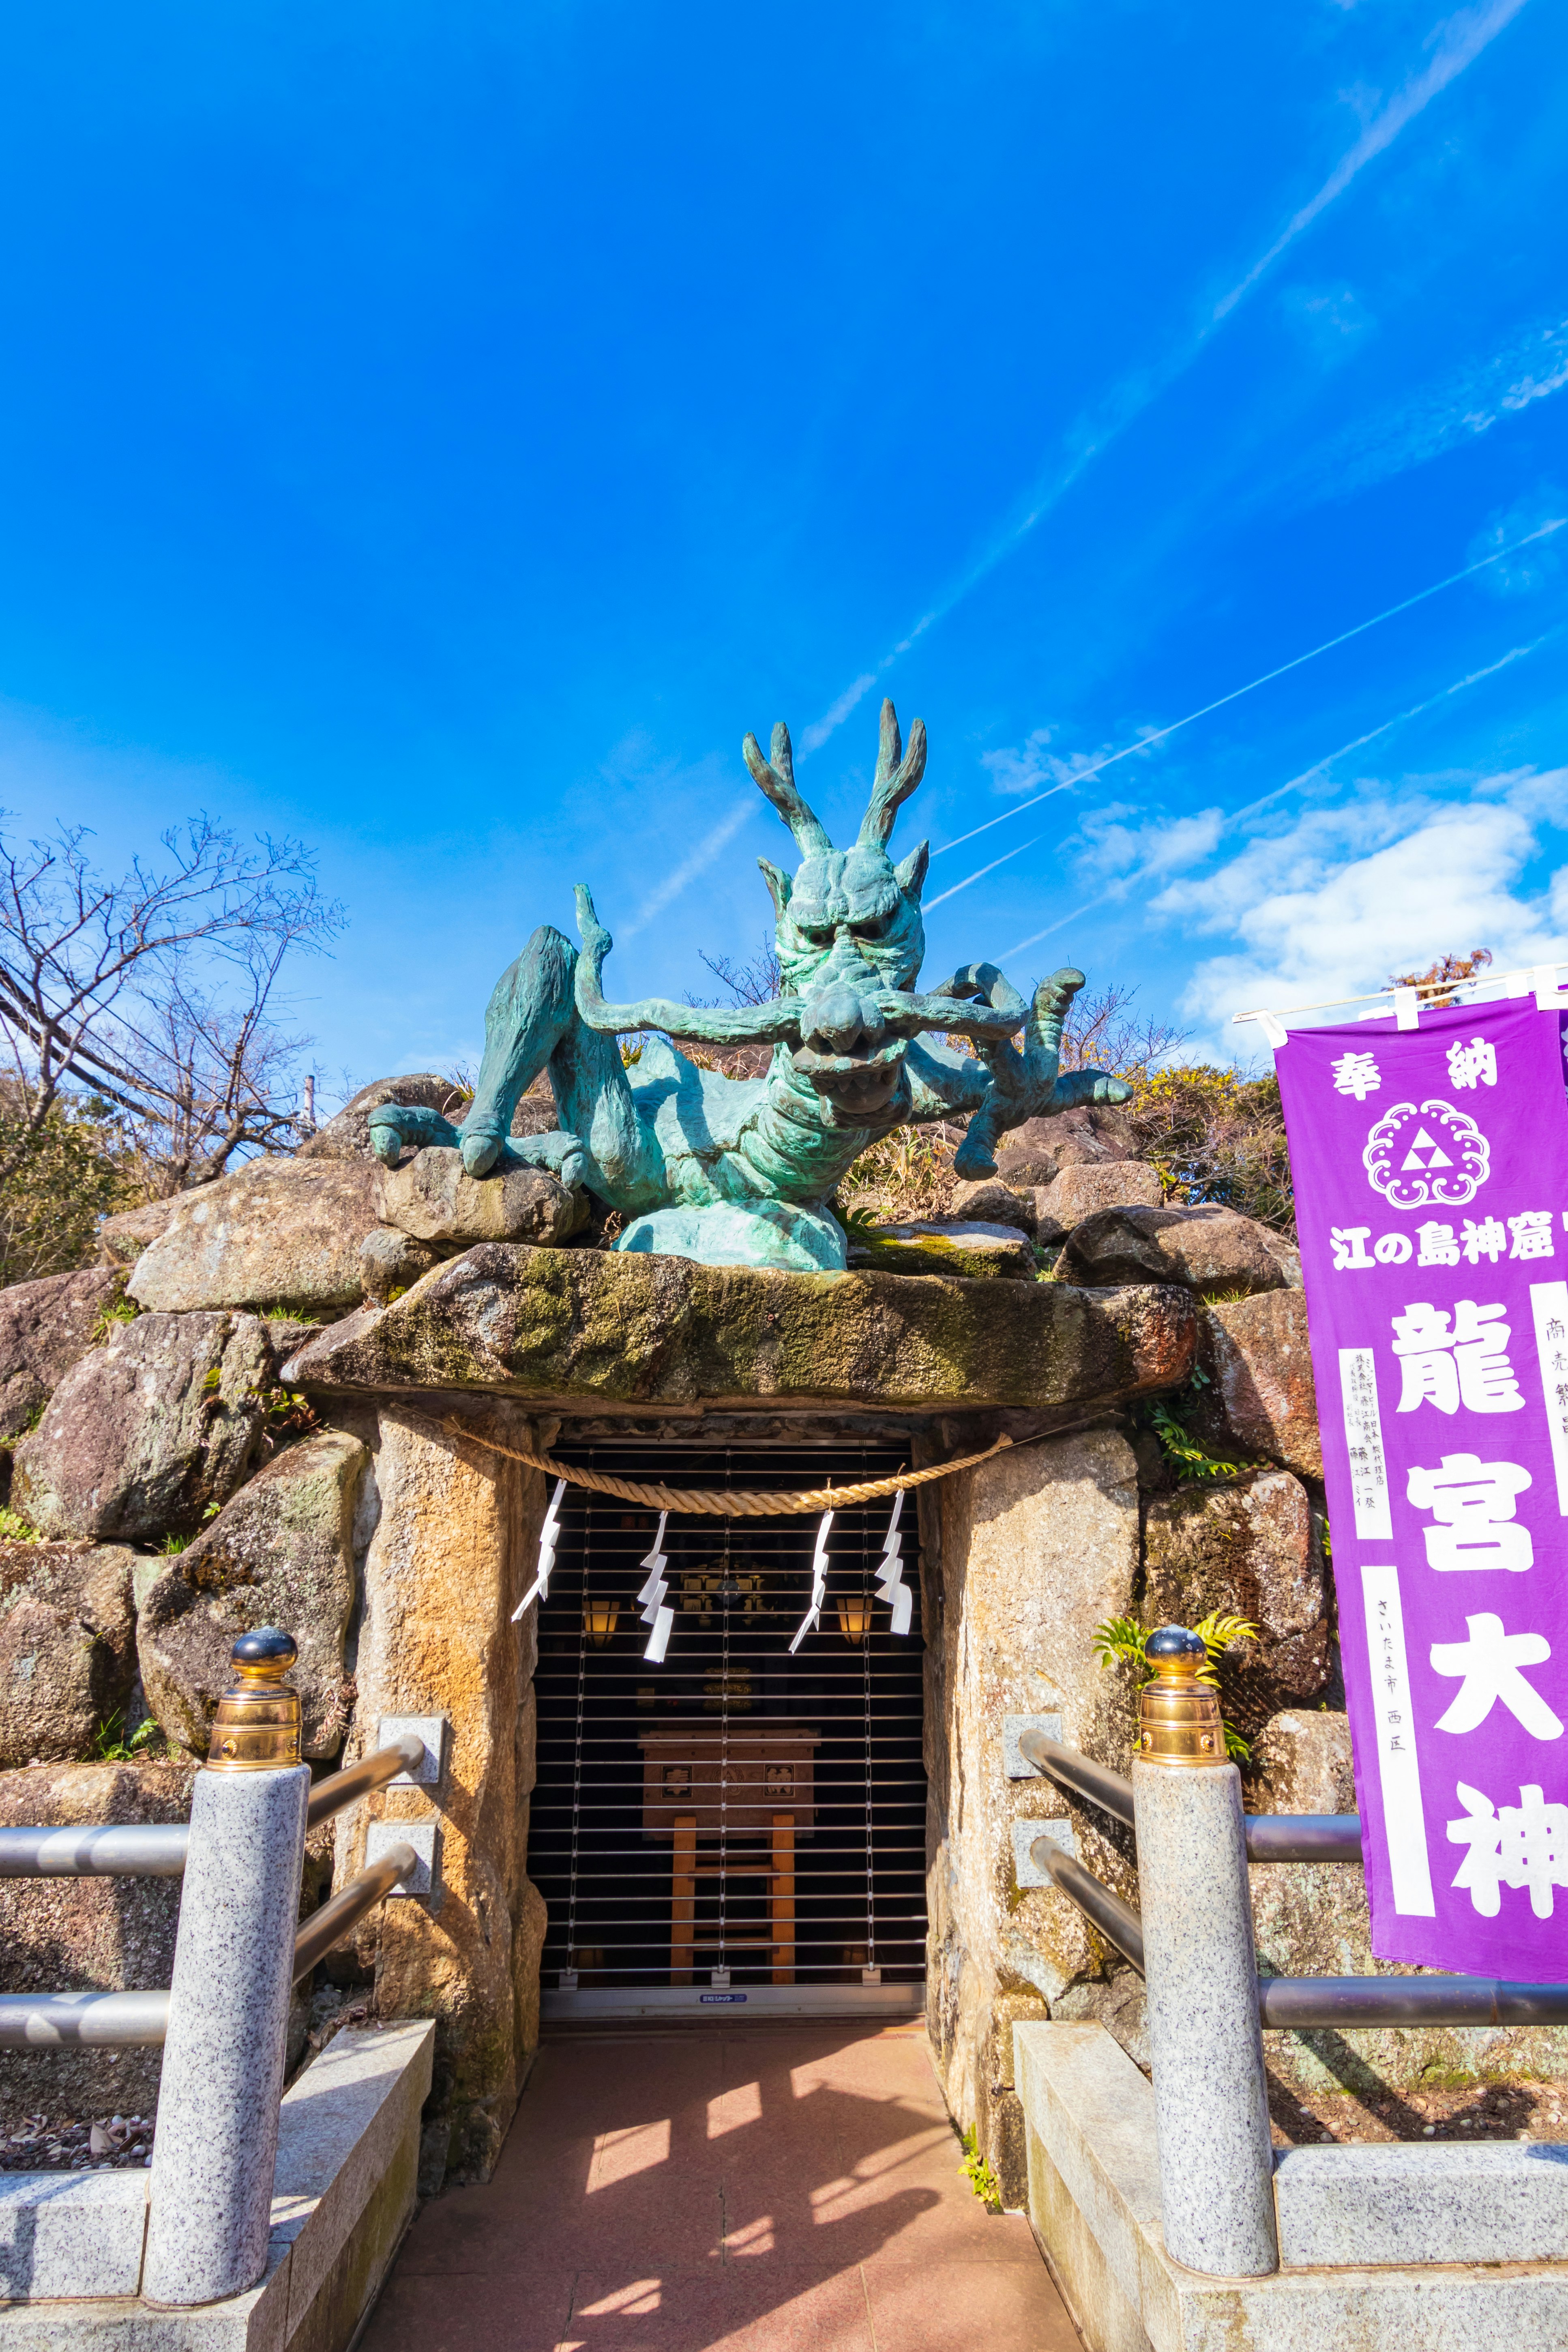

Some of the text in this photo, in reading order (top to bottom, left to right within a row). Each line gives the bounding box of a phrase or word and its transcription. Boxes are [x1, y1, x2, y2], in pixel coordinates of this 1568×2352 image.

[1330, 1204, 1554, 1270] 江の島神窟
[1378, 1600, 1406, 1751] さいたま市西区
[1392, 1300, 1568, 1919] 龍宮大神
